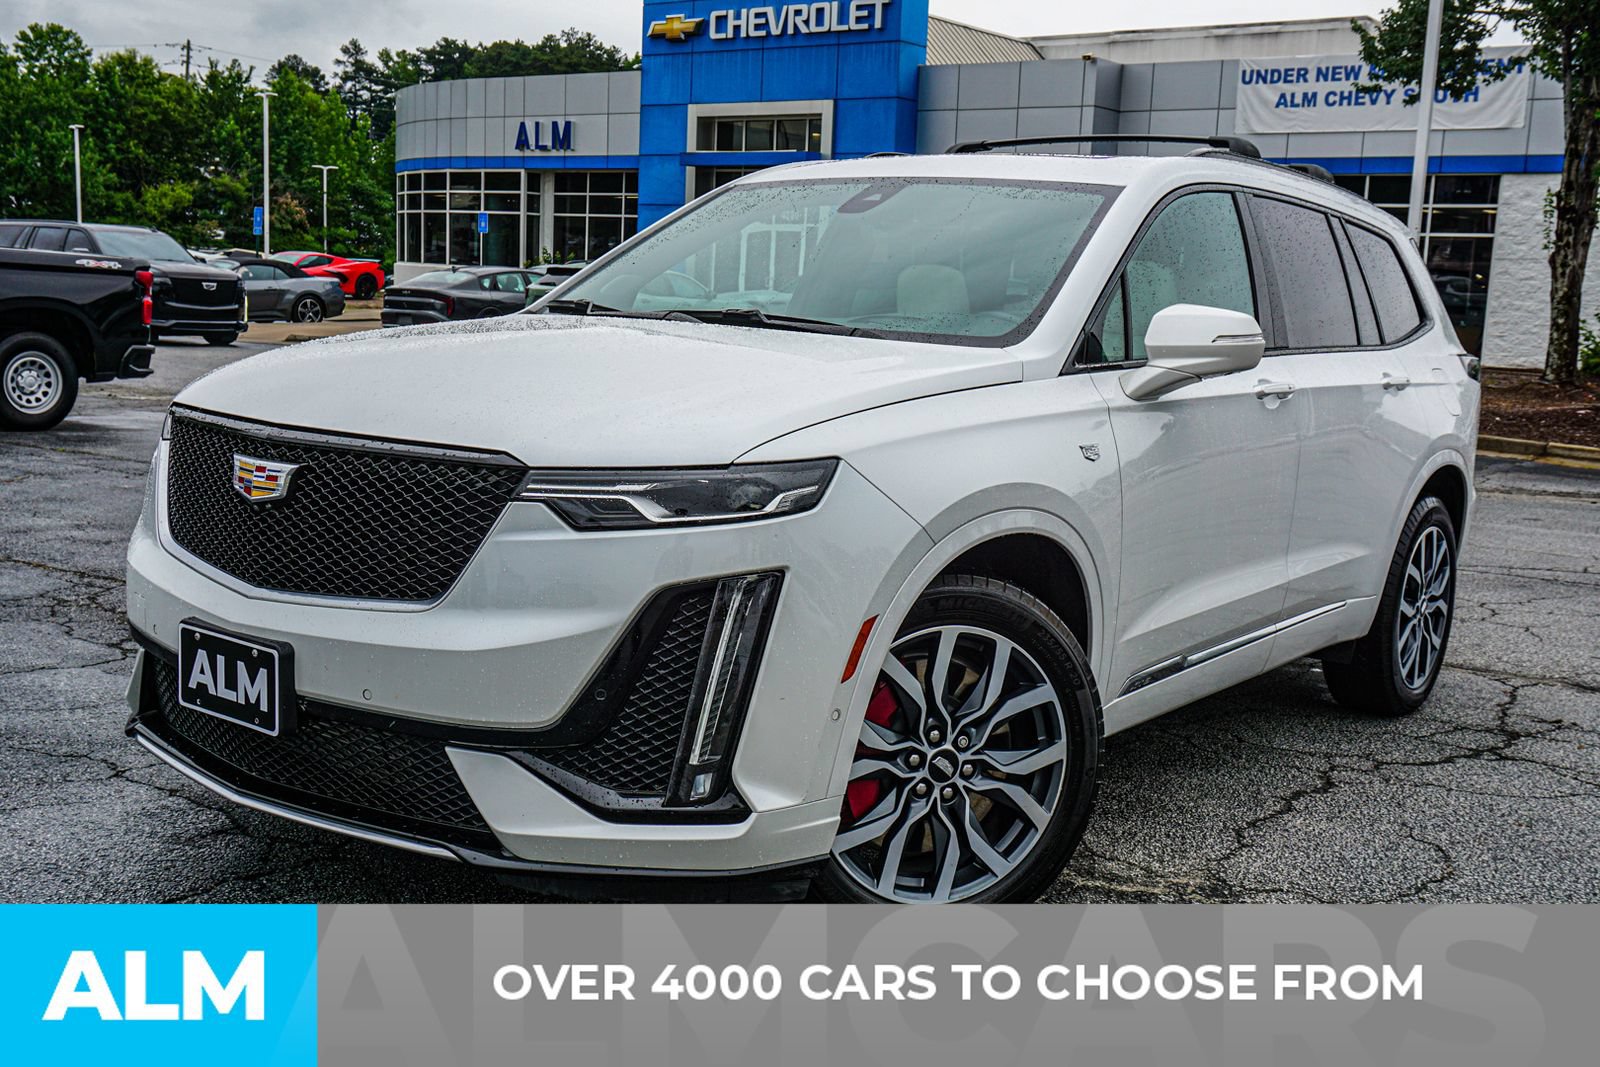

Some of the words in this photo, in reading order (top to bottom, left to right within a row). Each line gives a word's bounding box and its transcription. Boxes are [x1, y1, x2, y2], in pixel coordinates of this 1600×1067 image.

[709, 0, 889, 40] CHEVROLET
[1241, 67, 1309, 85] UNDER
[1315, 64, 1363, 83] NEW
[1274, 92, 1317, 109] ALM
[1324, 88, 1397, 108] CHEVY
[515, 120, 573, 150] ALM
[188, 648, 268, 713] ALM
